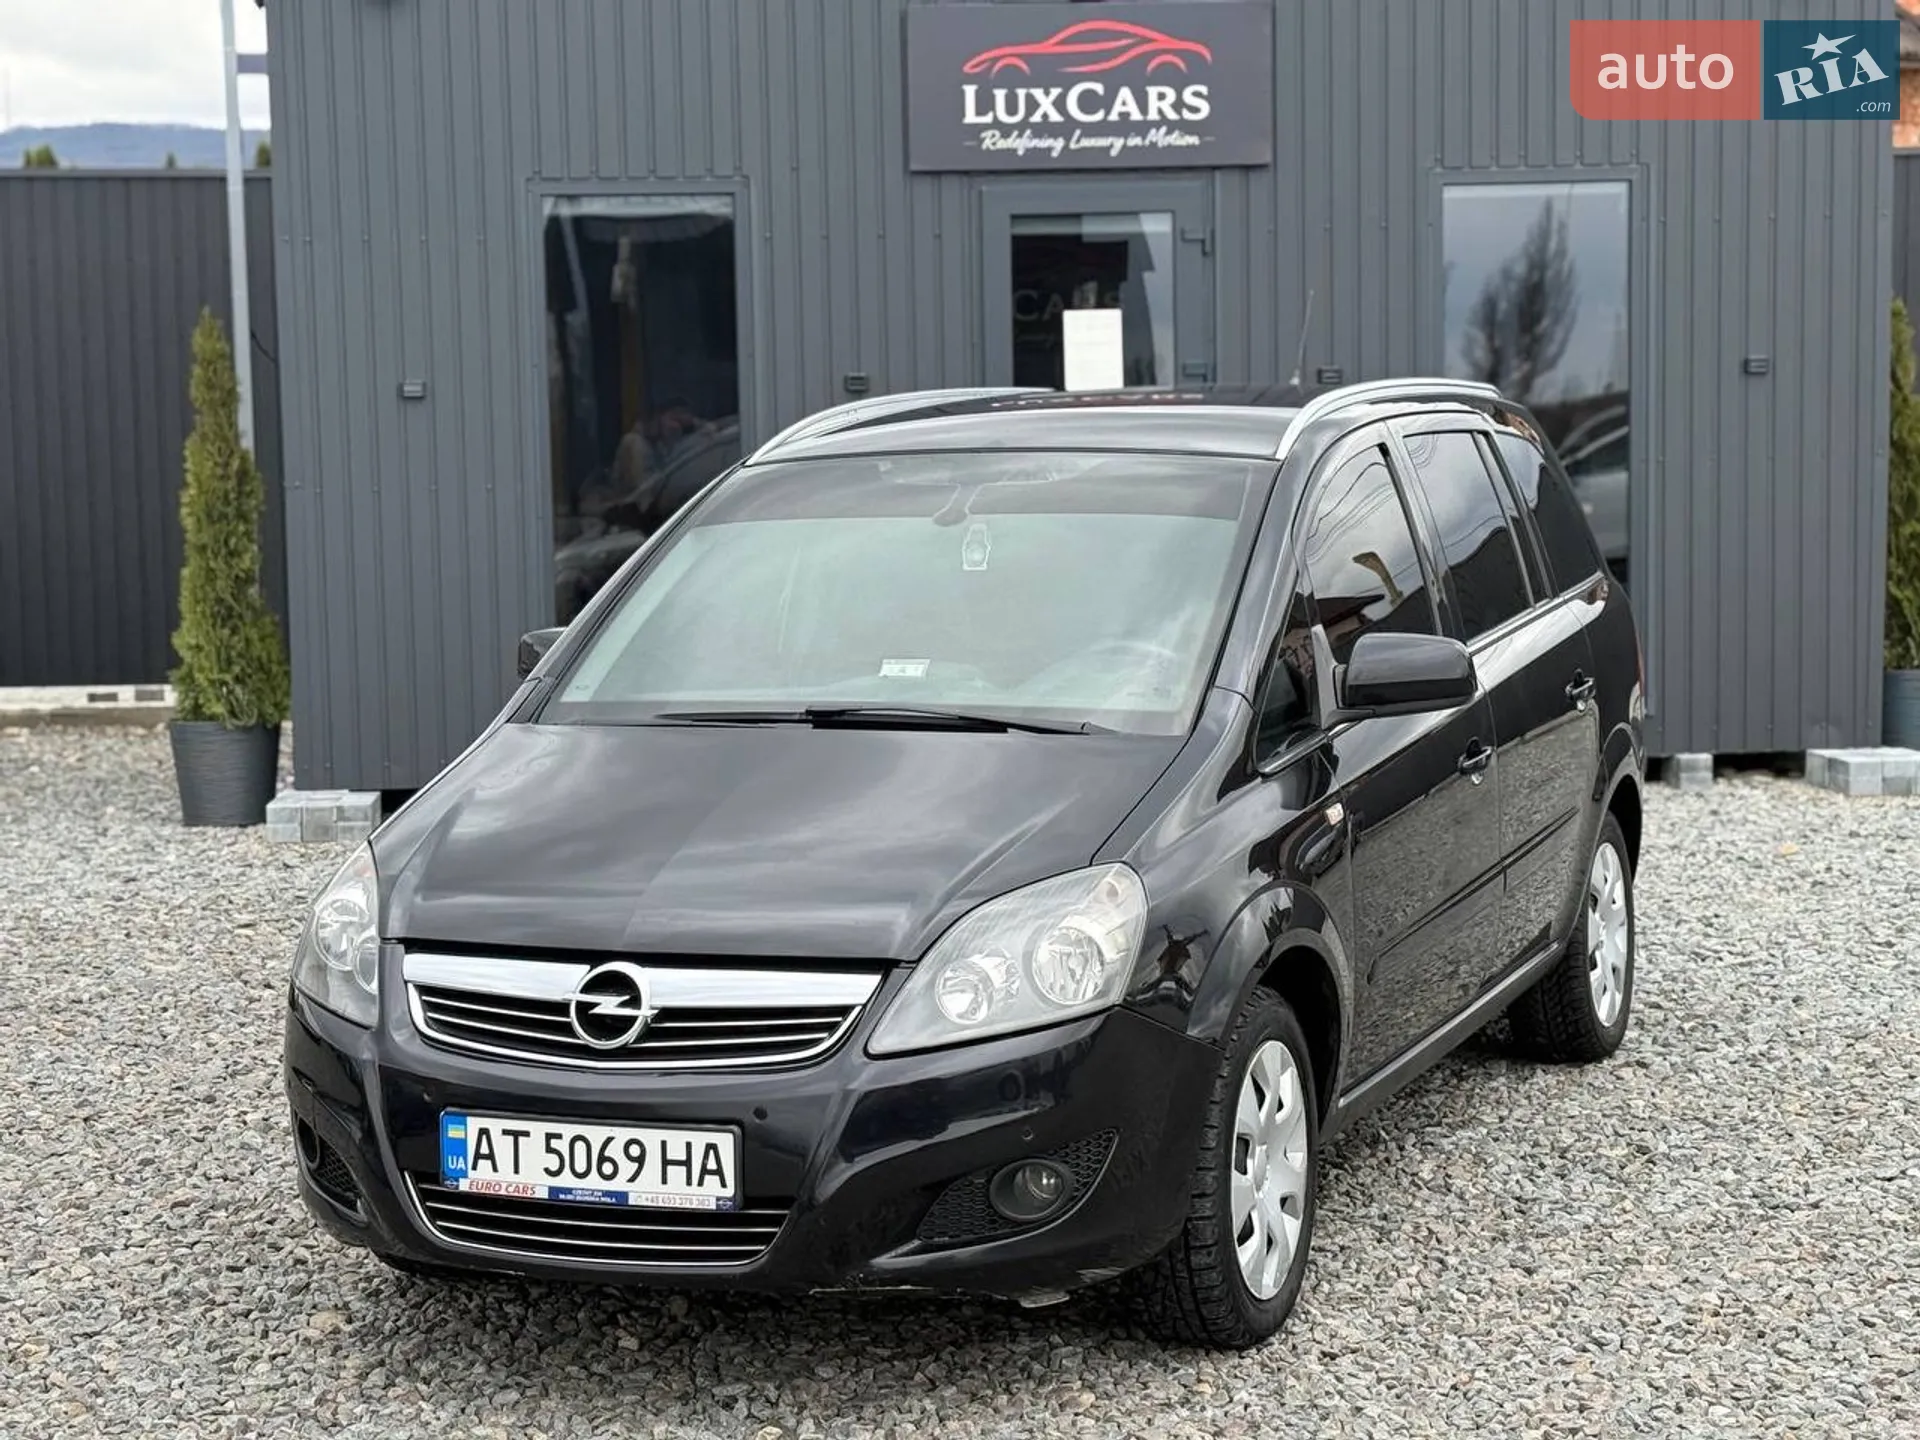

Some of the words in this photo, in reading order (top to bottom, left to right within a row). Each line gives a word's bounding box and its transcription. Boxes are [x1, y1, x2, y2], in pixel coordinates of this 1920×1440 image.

[980, 128, 1065, 157] Redefining
[1069, 129, 1124, 157] Luxury
[1127, 133, 1142, 147] in
[1144, 126, 1201, 148] Motion
[448, 1155, 466, 1170] UA
[471, 1127, 531, 1175] AT
[543, 1132, 647, 1183] 5069
[660, 1139, 728, 1189] HA
[468, 1180, 502, 1193] EURO
[505, 1183, 536, 1196] CARS
